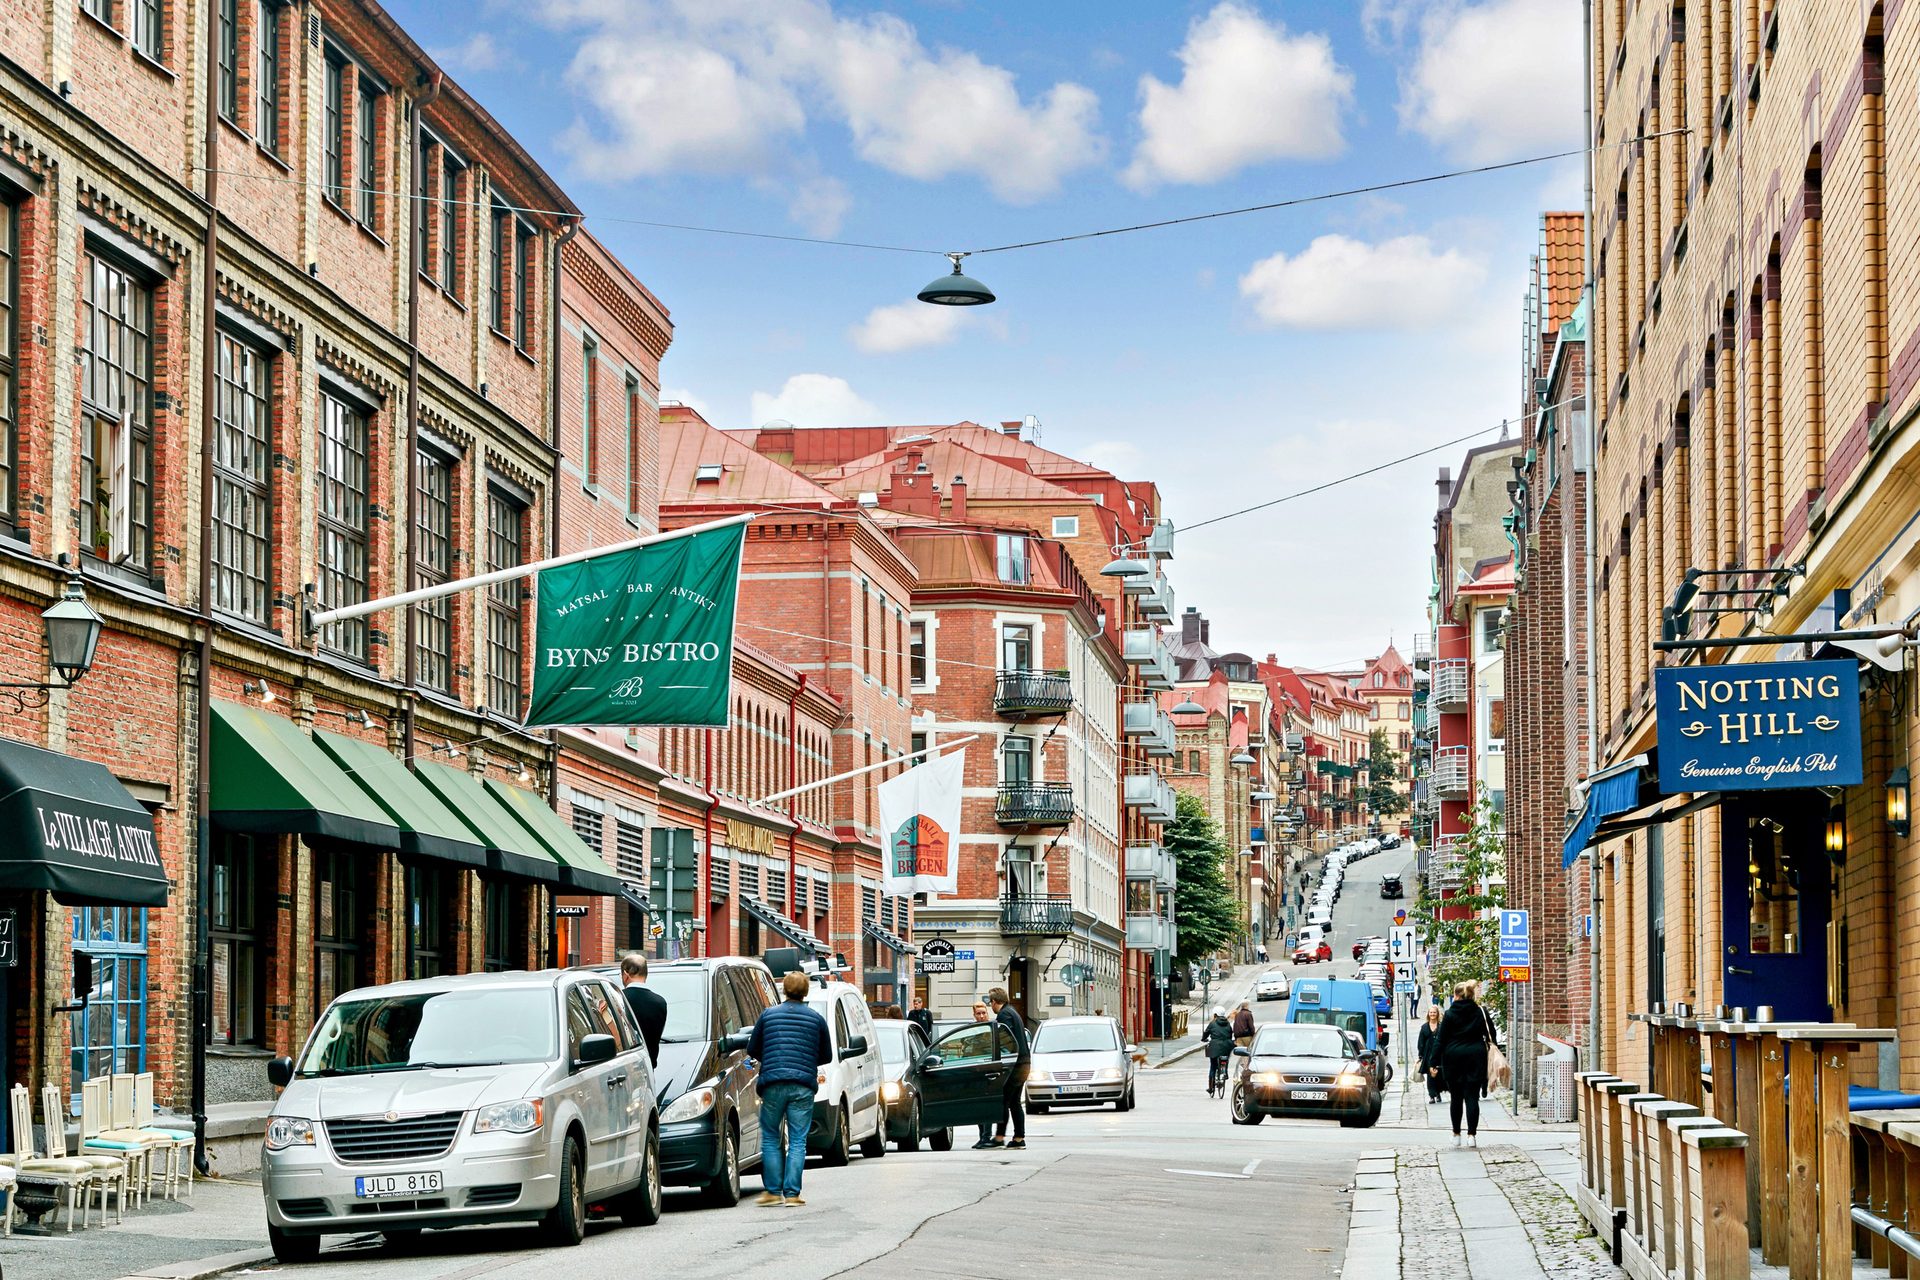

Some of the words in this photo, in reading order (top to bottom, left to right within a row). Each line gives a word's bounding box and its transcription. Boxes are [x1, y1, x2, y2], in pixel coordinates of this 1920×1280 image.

[556, 589, 609, 617] MATSAL
[627, 583, 653, 593] BAR
[670, 586, 717, 612] ANTIKT
[547, 646, 613, 668] BYNS
[623, 642, 720, 663] BISTRO
[609, 676, 644, 699] BB
[1676, 675, 1840, 711] NOTTING
[1718, 712, 1803, 744] HILL
[1680, 758, 1742, 778] Genuine
[1744, 756, 1802, 781] English
[1804, 753, 1838, 772] Pub
[115, 823, 160, 867] ANTIK
[1508, 913, 1522, 934] P
[925, 940, 952, 951] SALUHALL
[923, 962, 954, 971] BRIGGEN
[367, 1177, 396, 1192] JLD
[408, 1174, 438, 1190] 816
